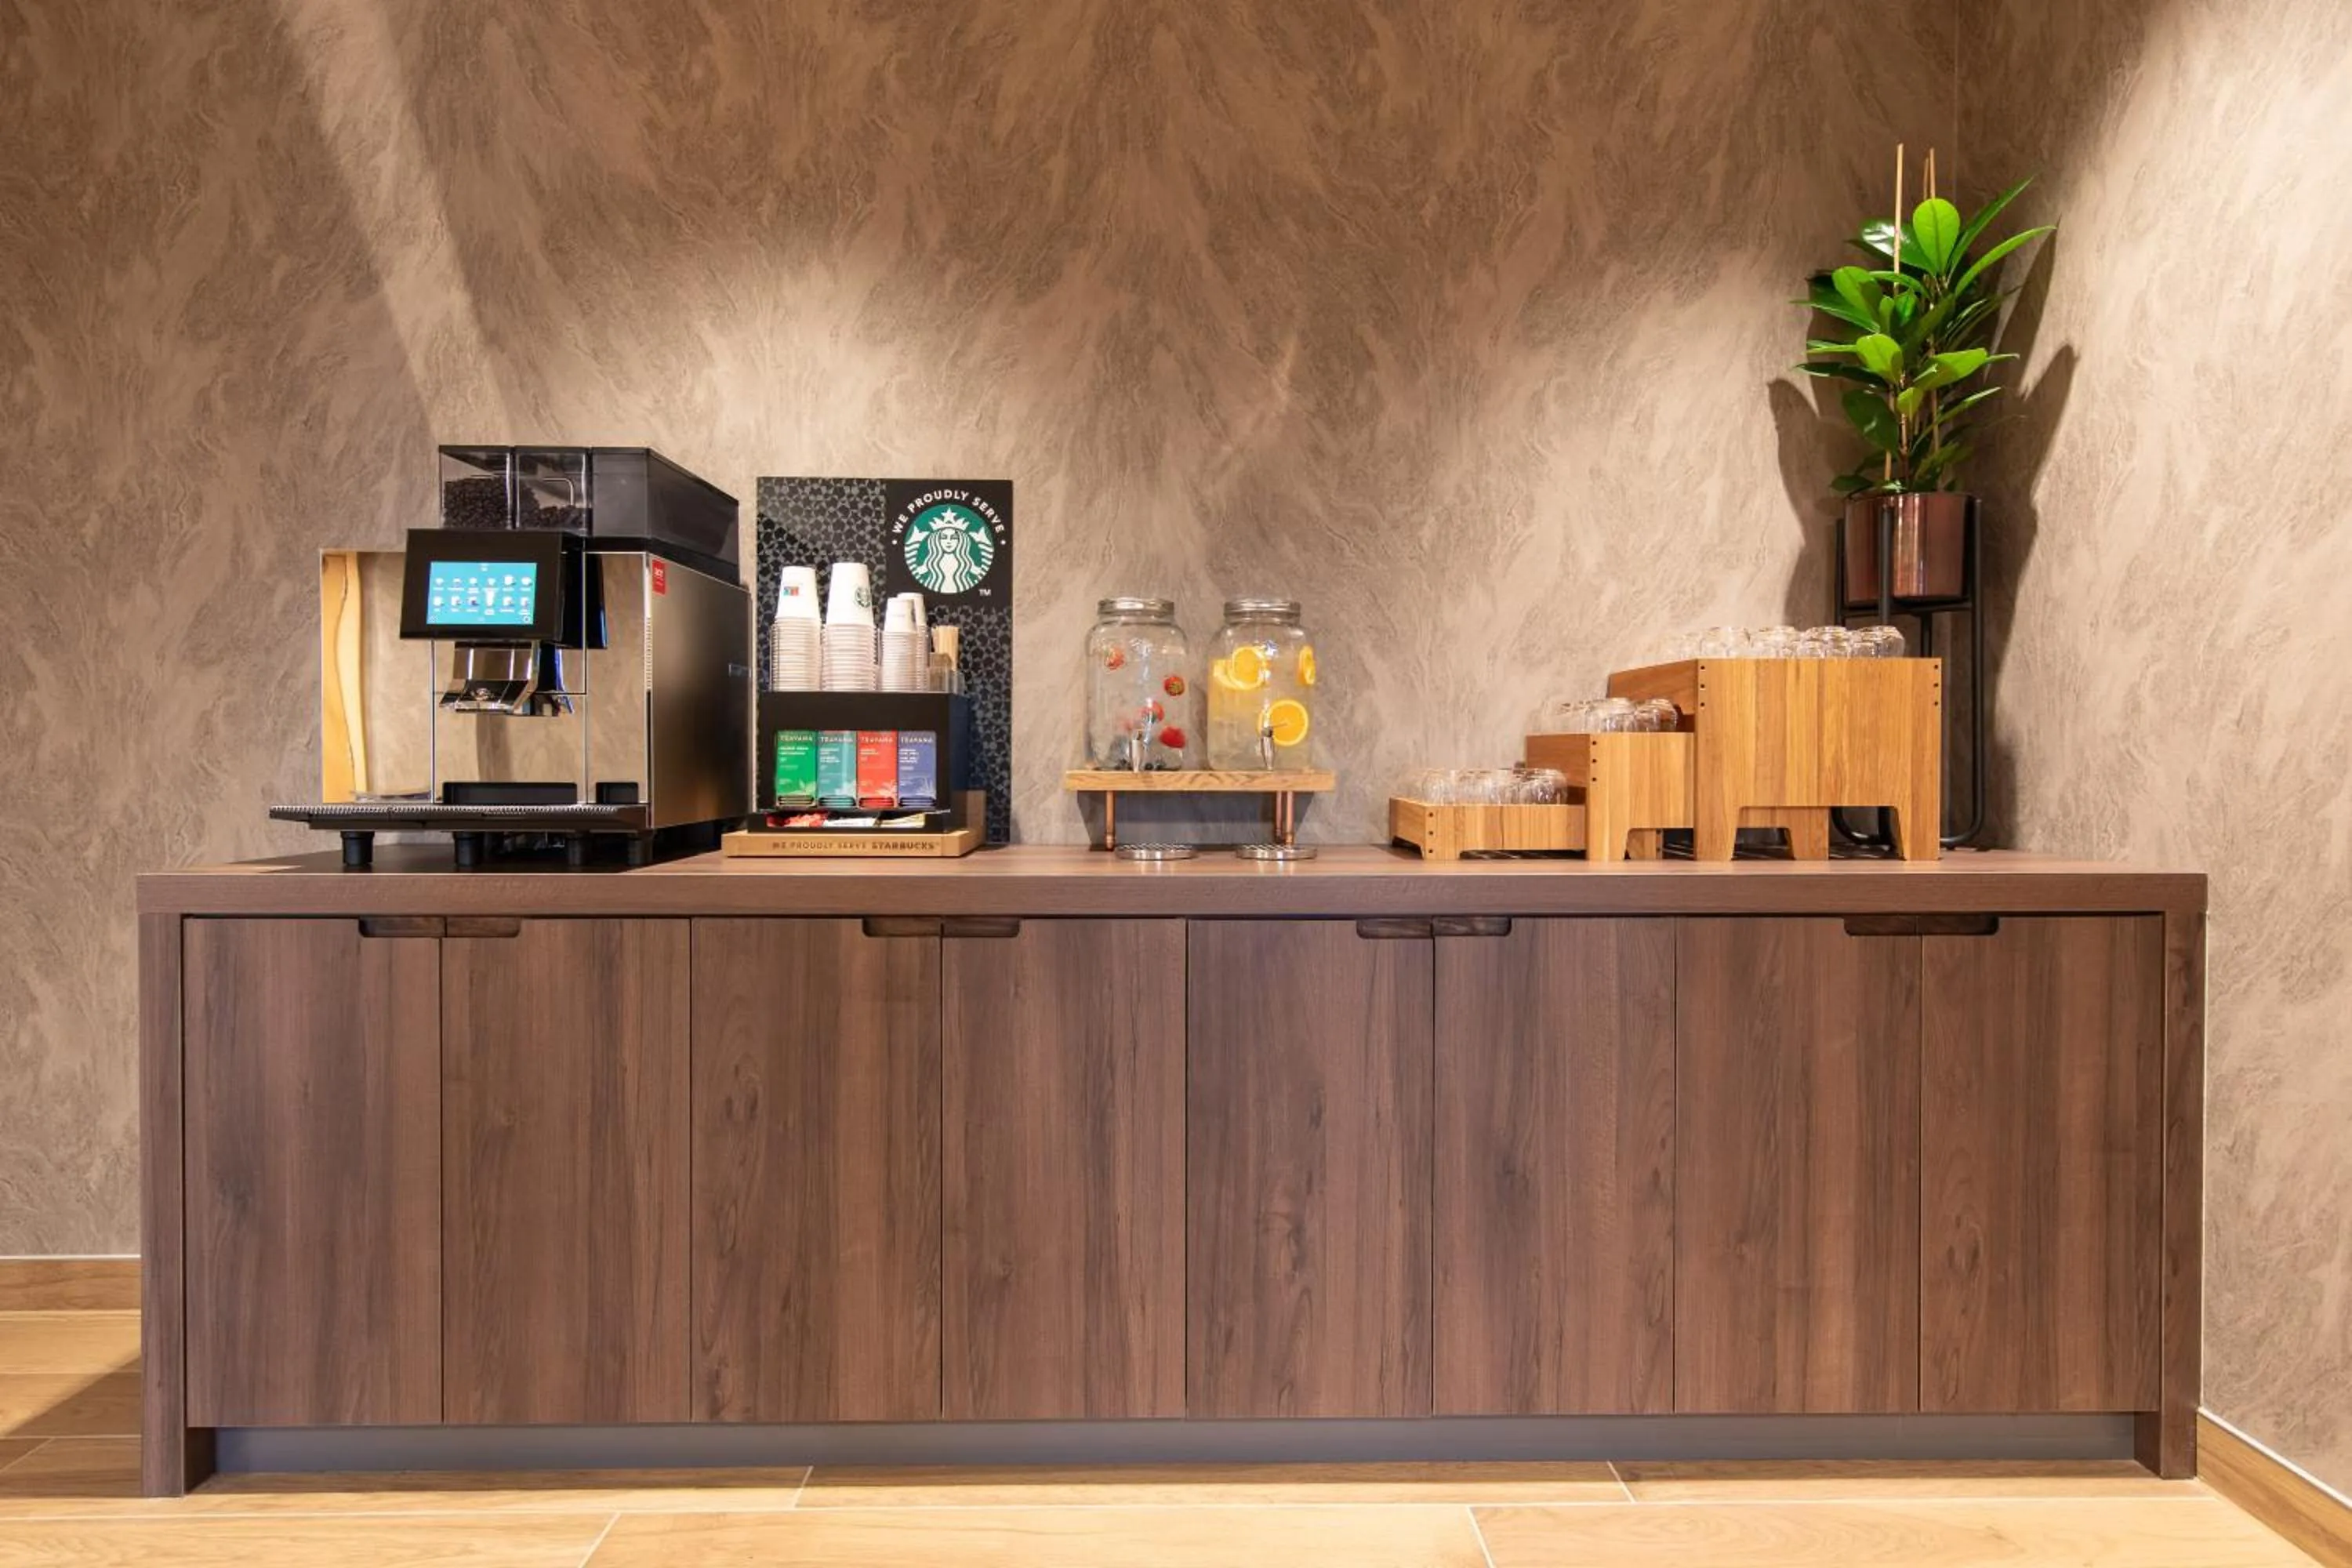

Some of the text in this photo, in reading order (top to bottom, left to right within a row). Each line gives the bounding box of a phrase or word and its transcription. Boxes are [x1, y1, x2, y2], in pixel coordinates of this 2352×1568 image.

[892, 489, 1005, 533] WE PROUDLY SERVE
